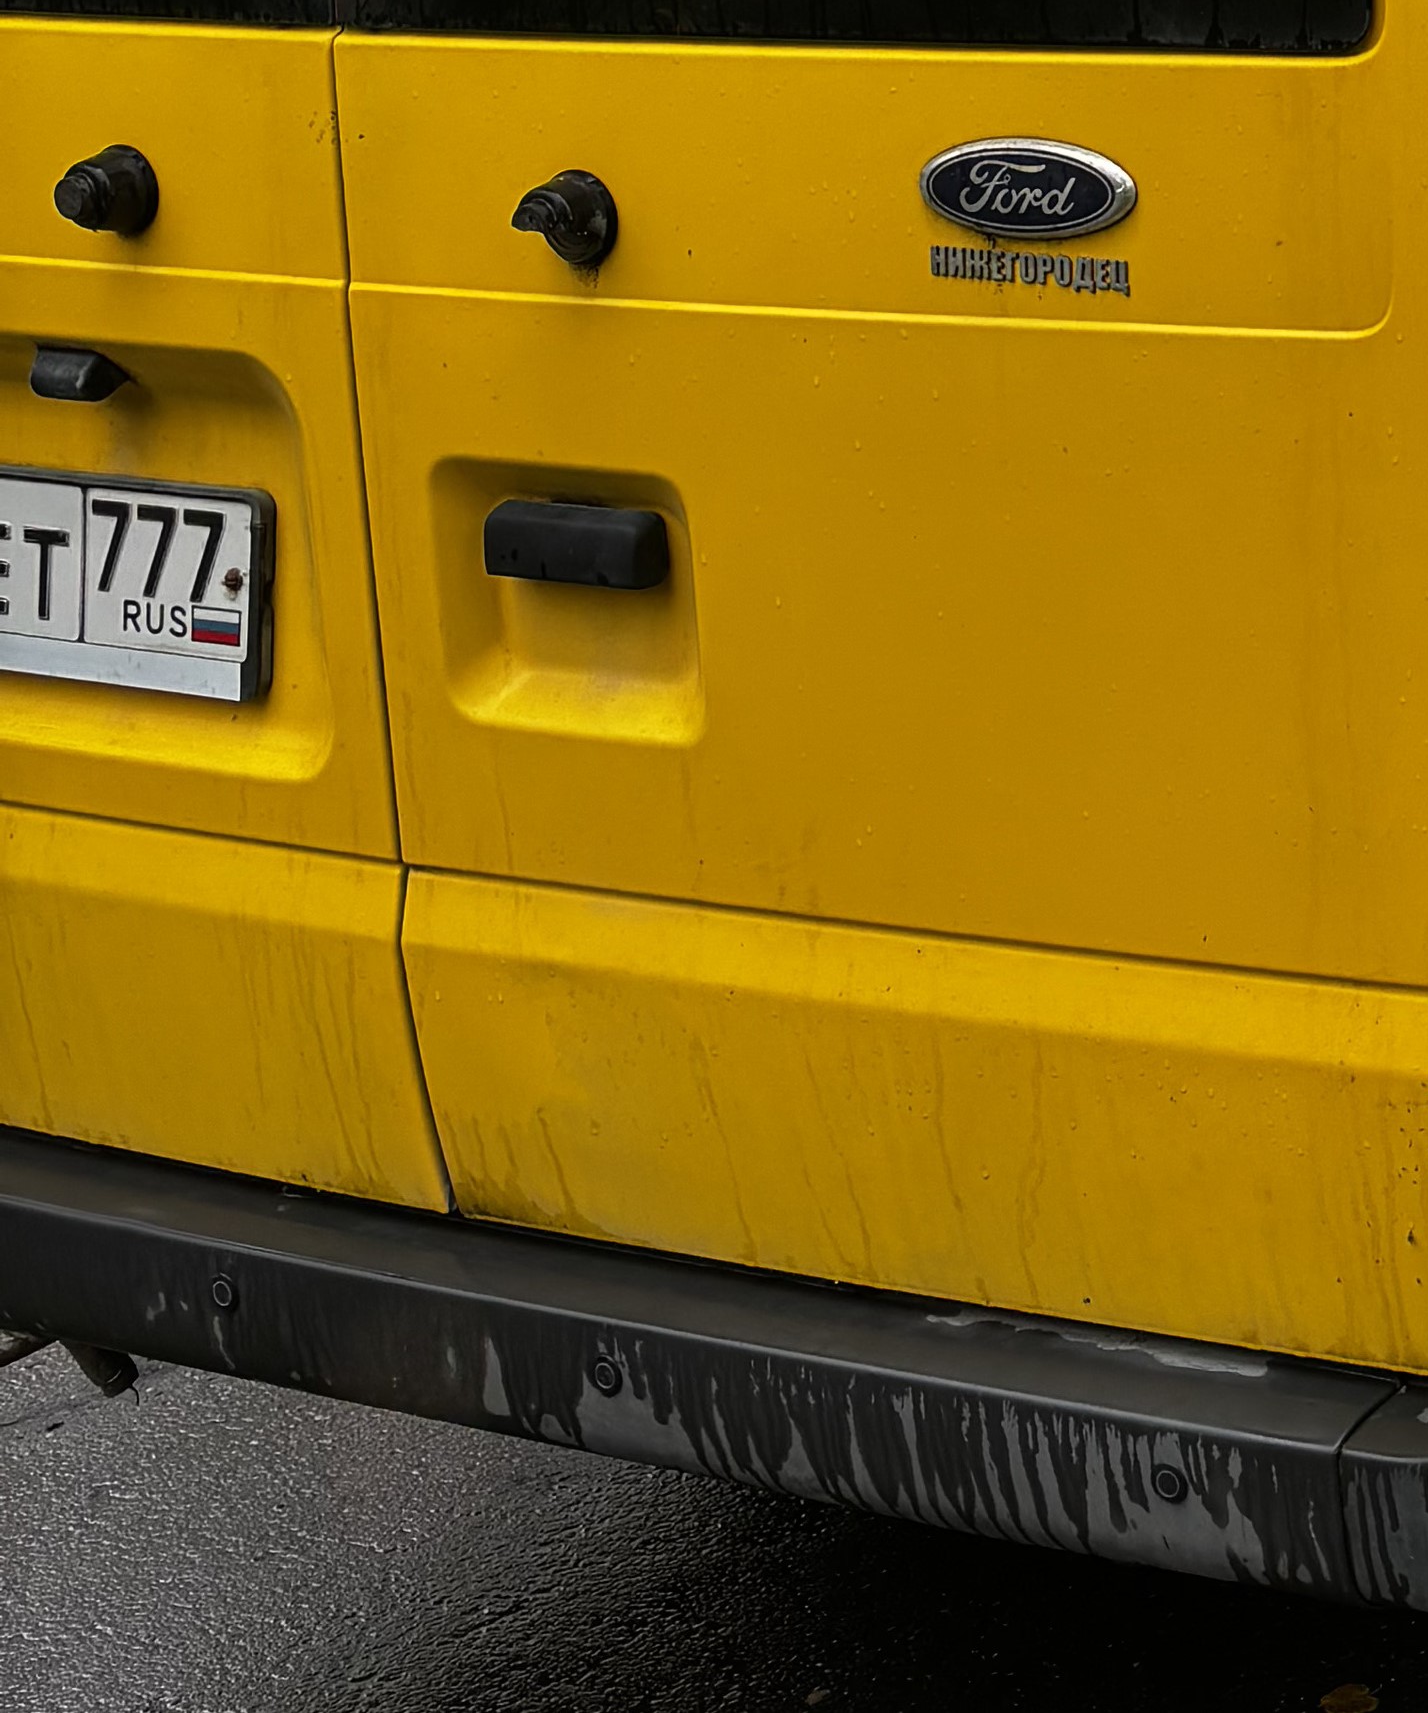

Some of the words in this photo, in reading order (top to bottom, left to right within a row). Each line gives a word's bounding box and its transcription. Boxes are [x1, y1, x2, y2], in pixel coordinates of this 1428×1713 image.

[959, 159, 1076, 216] Ford
[930, 245, 1131, 297] НИЖЕГОРОДЕЦ
[91, 498, 227, 603] 777
[122, 599, 188, 637] RUS
